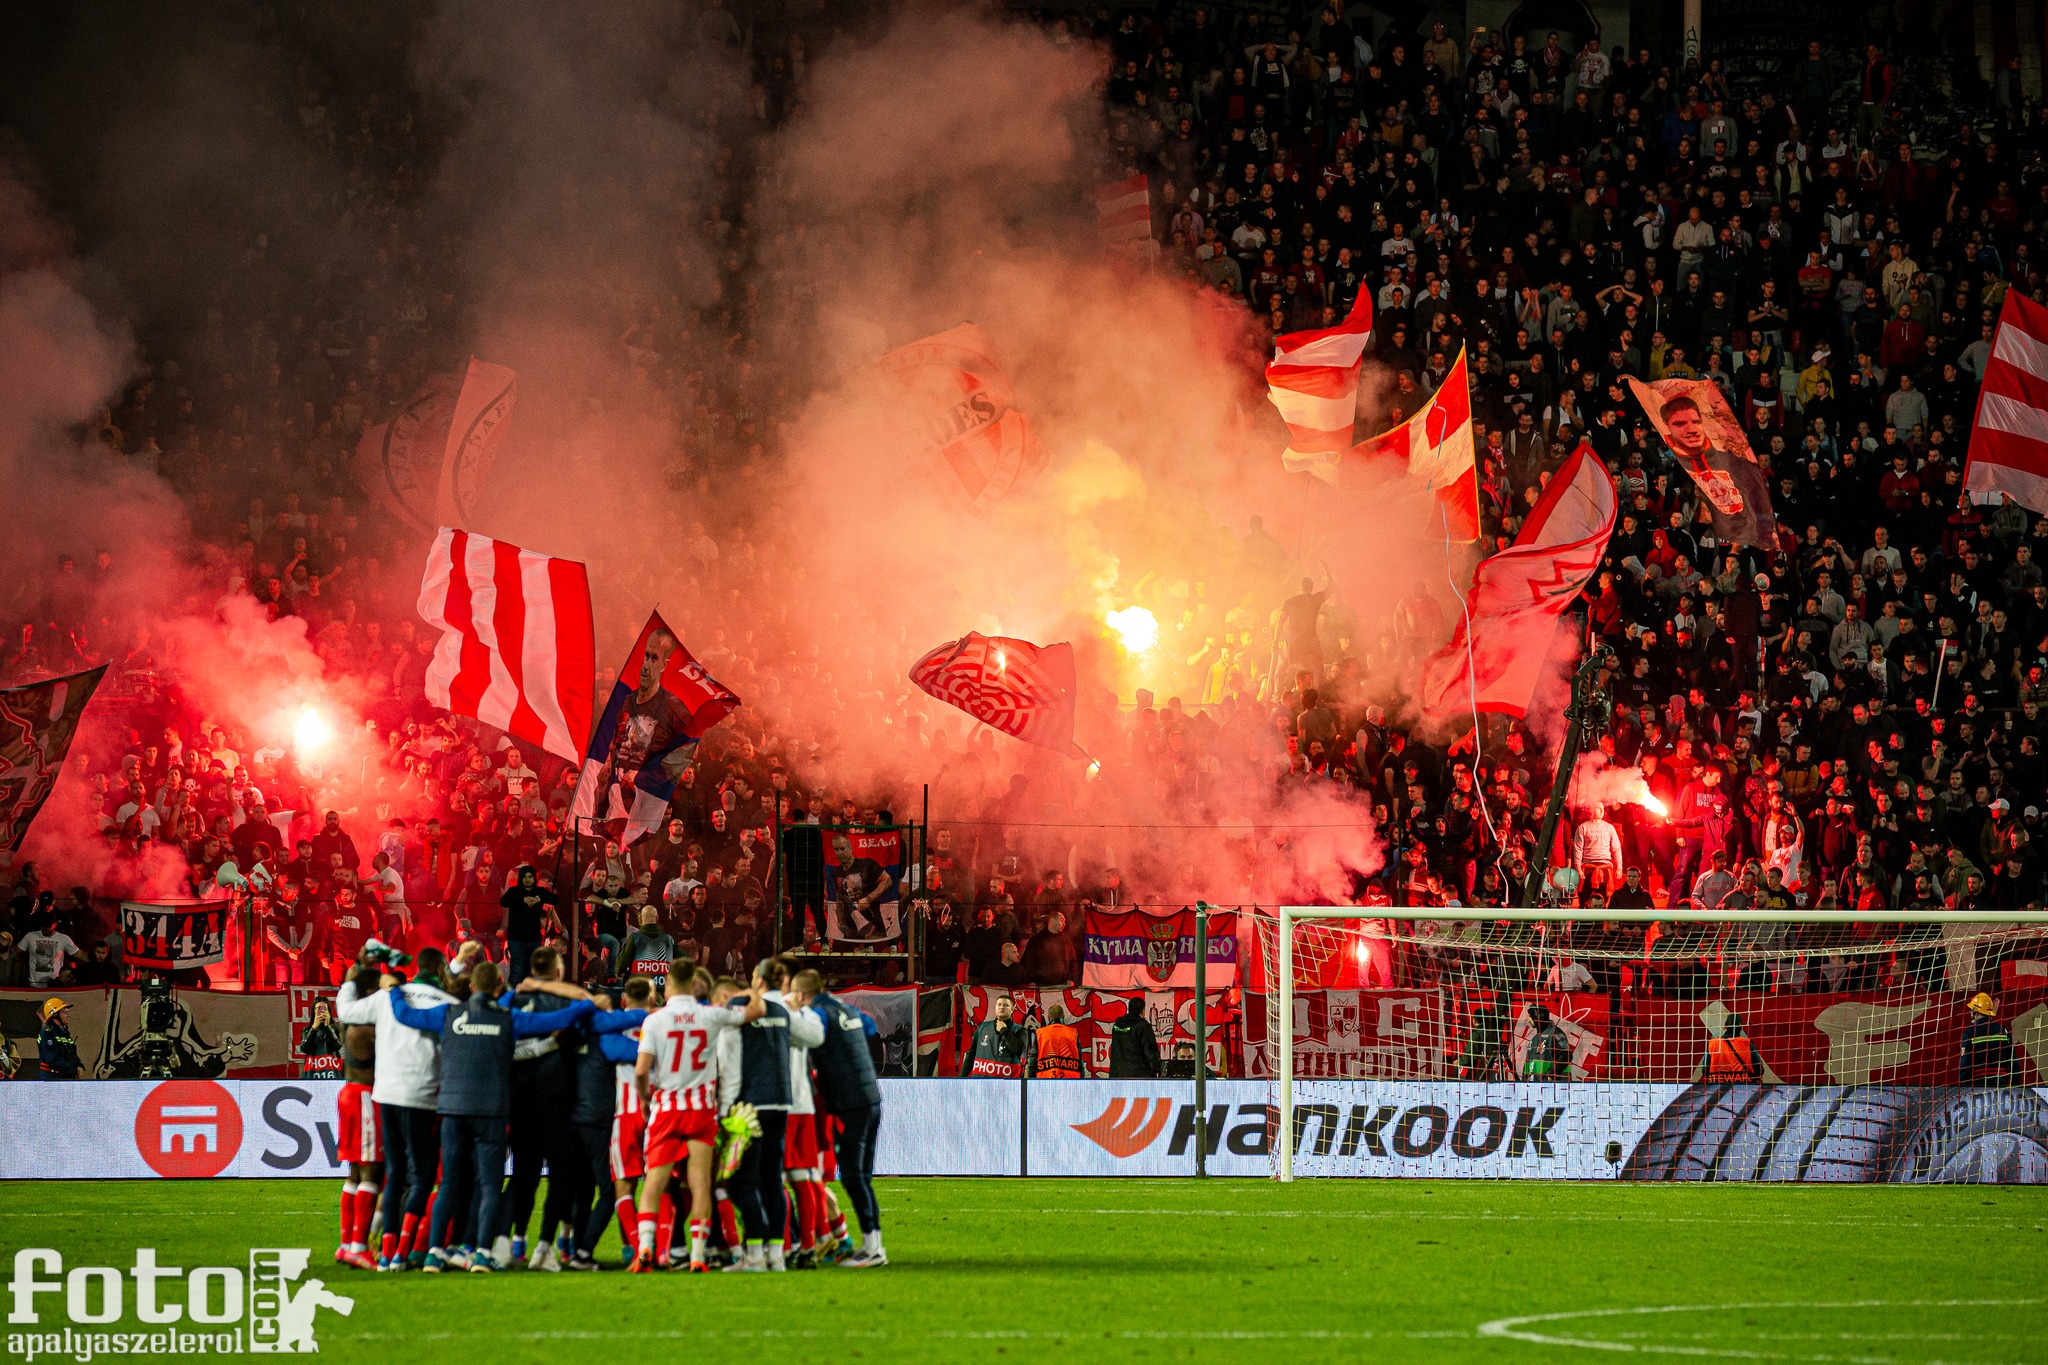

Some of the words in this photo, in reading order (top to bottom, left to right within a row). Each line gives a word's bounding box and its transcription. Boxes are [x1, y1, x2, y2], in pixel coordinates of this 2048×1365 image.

[1088, 937, 1144, 963] КУМА
[667, 1029, 708, 1073] 72
[973, 1060, 1012, 1076] PHOTO
[1037, 1057, 1079, 1070] STEWARD
